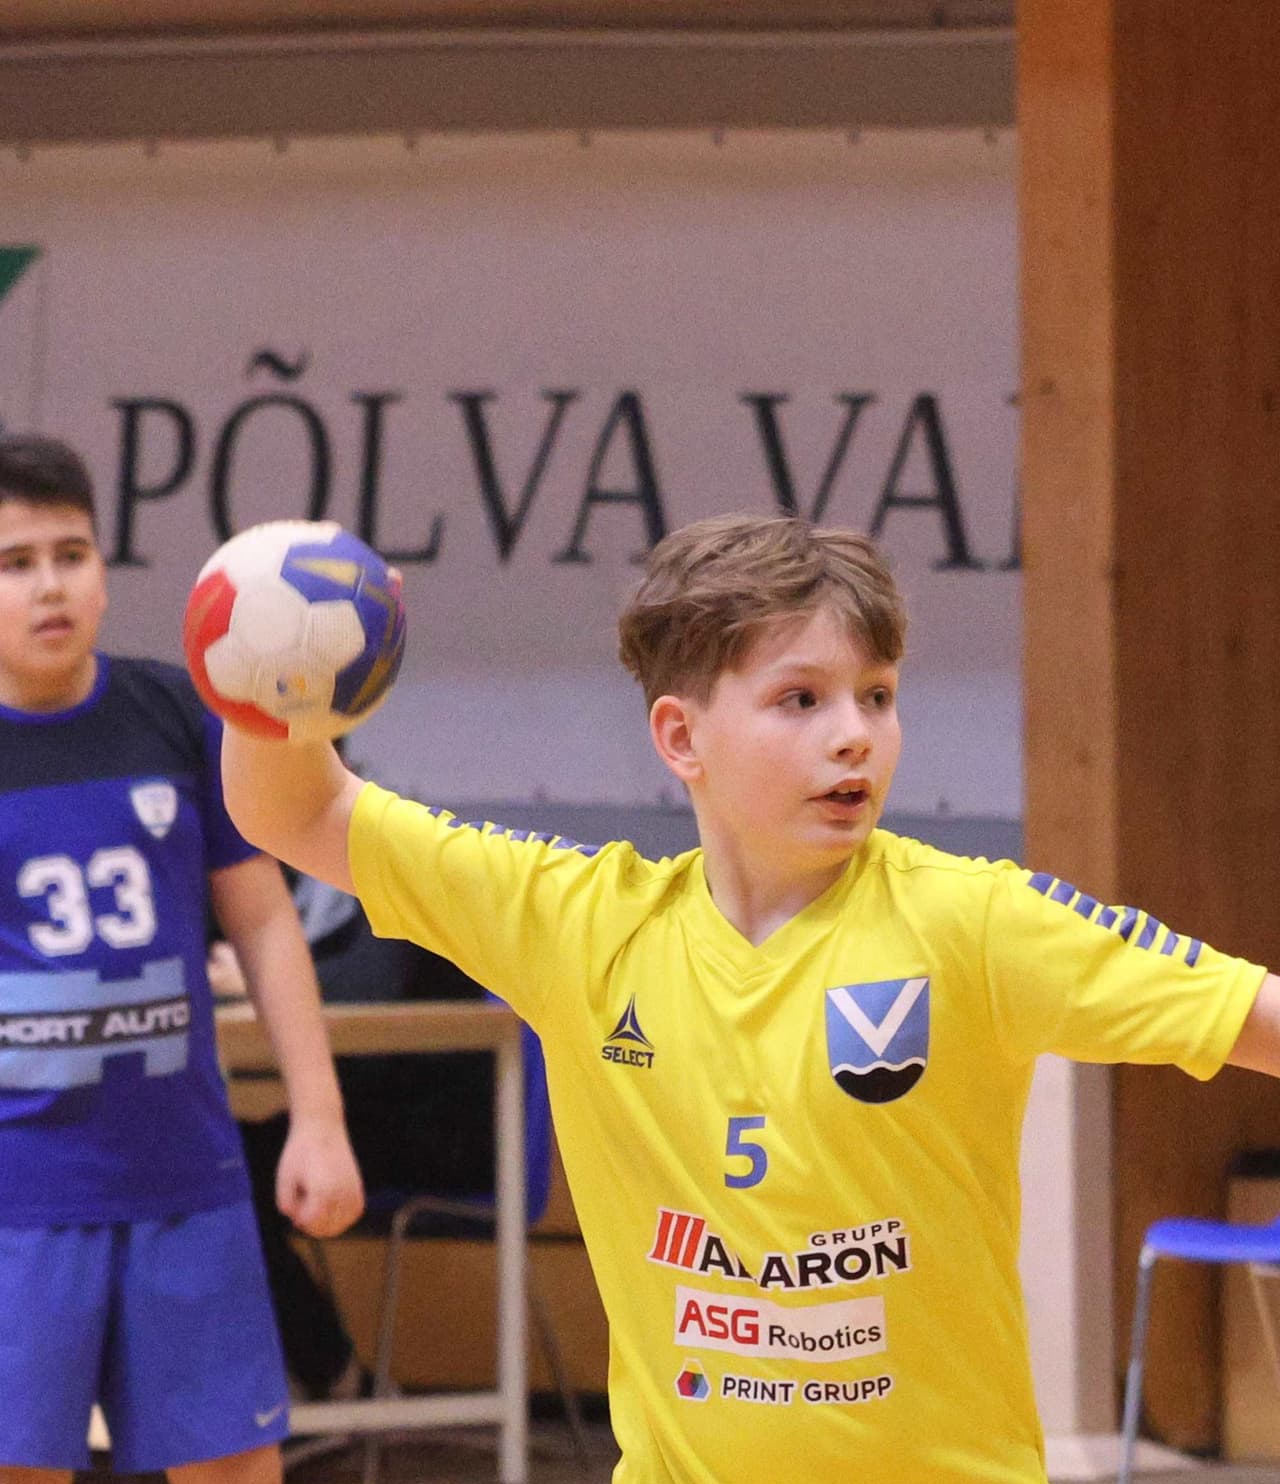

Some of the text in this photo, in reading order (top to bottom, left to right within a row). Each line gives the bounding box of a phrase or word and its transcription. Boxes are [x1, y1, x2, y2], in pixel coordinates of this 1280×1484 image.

[106, 349, 1021, 570] PÕLVA VA
[16, 845, 158, 958] 33
[101, 999, 191, 1038] AUTO
[601, 1045, 655, 1069] SELECT
[724, 1115, 768, 1190] 5
[811, 1220, 901, 1247] GRUPP
[678, 1299, 882, 1352] ASG Robotics
[722, 1376, 892, 1402] PRINT GRUPP
